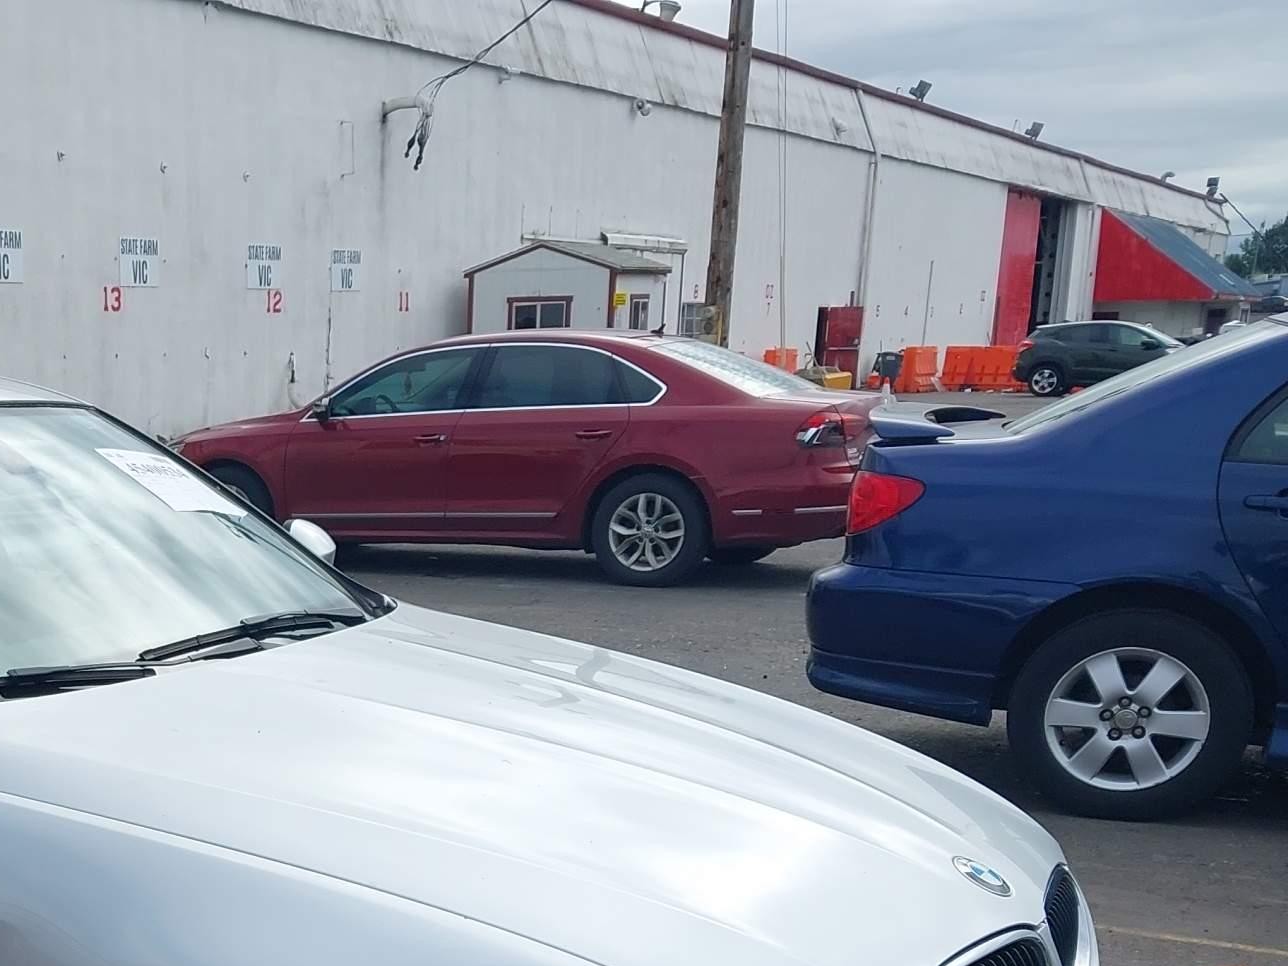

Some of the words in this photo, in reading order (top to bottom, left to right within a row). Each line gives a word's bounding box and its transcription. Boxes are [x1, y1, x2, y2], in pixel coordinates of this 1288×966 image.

[0, 230, 21, 249] FARM
[120, 238, 138, 255] STATE
[139, 239, 159, 256] FARM
[248, 245, 264, 261] STATE
[265, 246, 282, 261] FARM
[132, 259, 148, 285] VIC
[258, 264, 272, 287] VIC
[340, 268, 353, 289] VIC
[103, 286, 121, 312] 13
[266, 289, 283, 313] 12
[399, 291, 409, 312] 11
